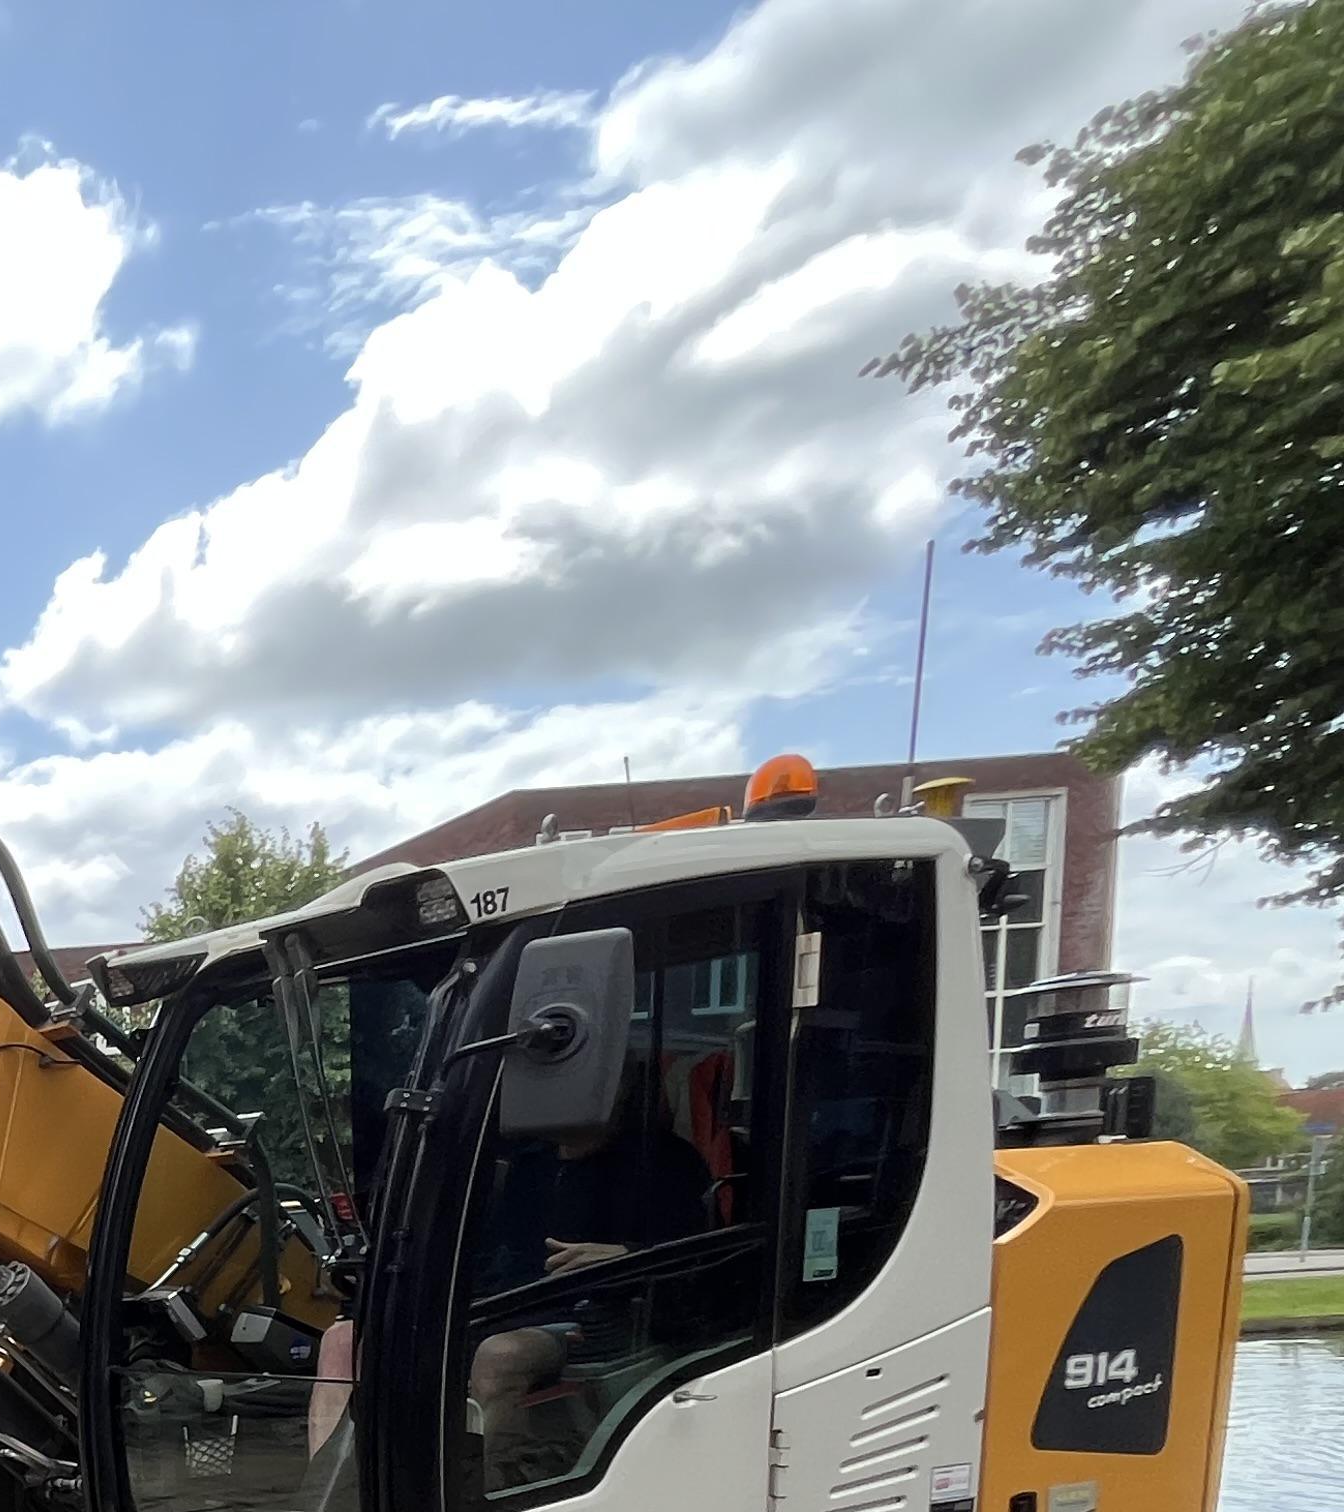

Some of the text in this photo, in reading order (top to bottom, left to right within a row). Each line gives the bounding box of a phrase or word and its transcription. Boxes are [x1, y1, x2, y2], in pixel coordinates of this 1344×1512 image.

[470, 886, 510, 918] 187
[1064, 1348, 1138, 1390] 914
[1087, 1373, 1163, 1409] compact
